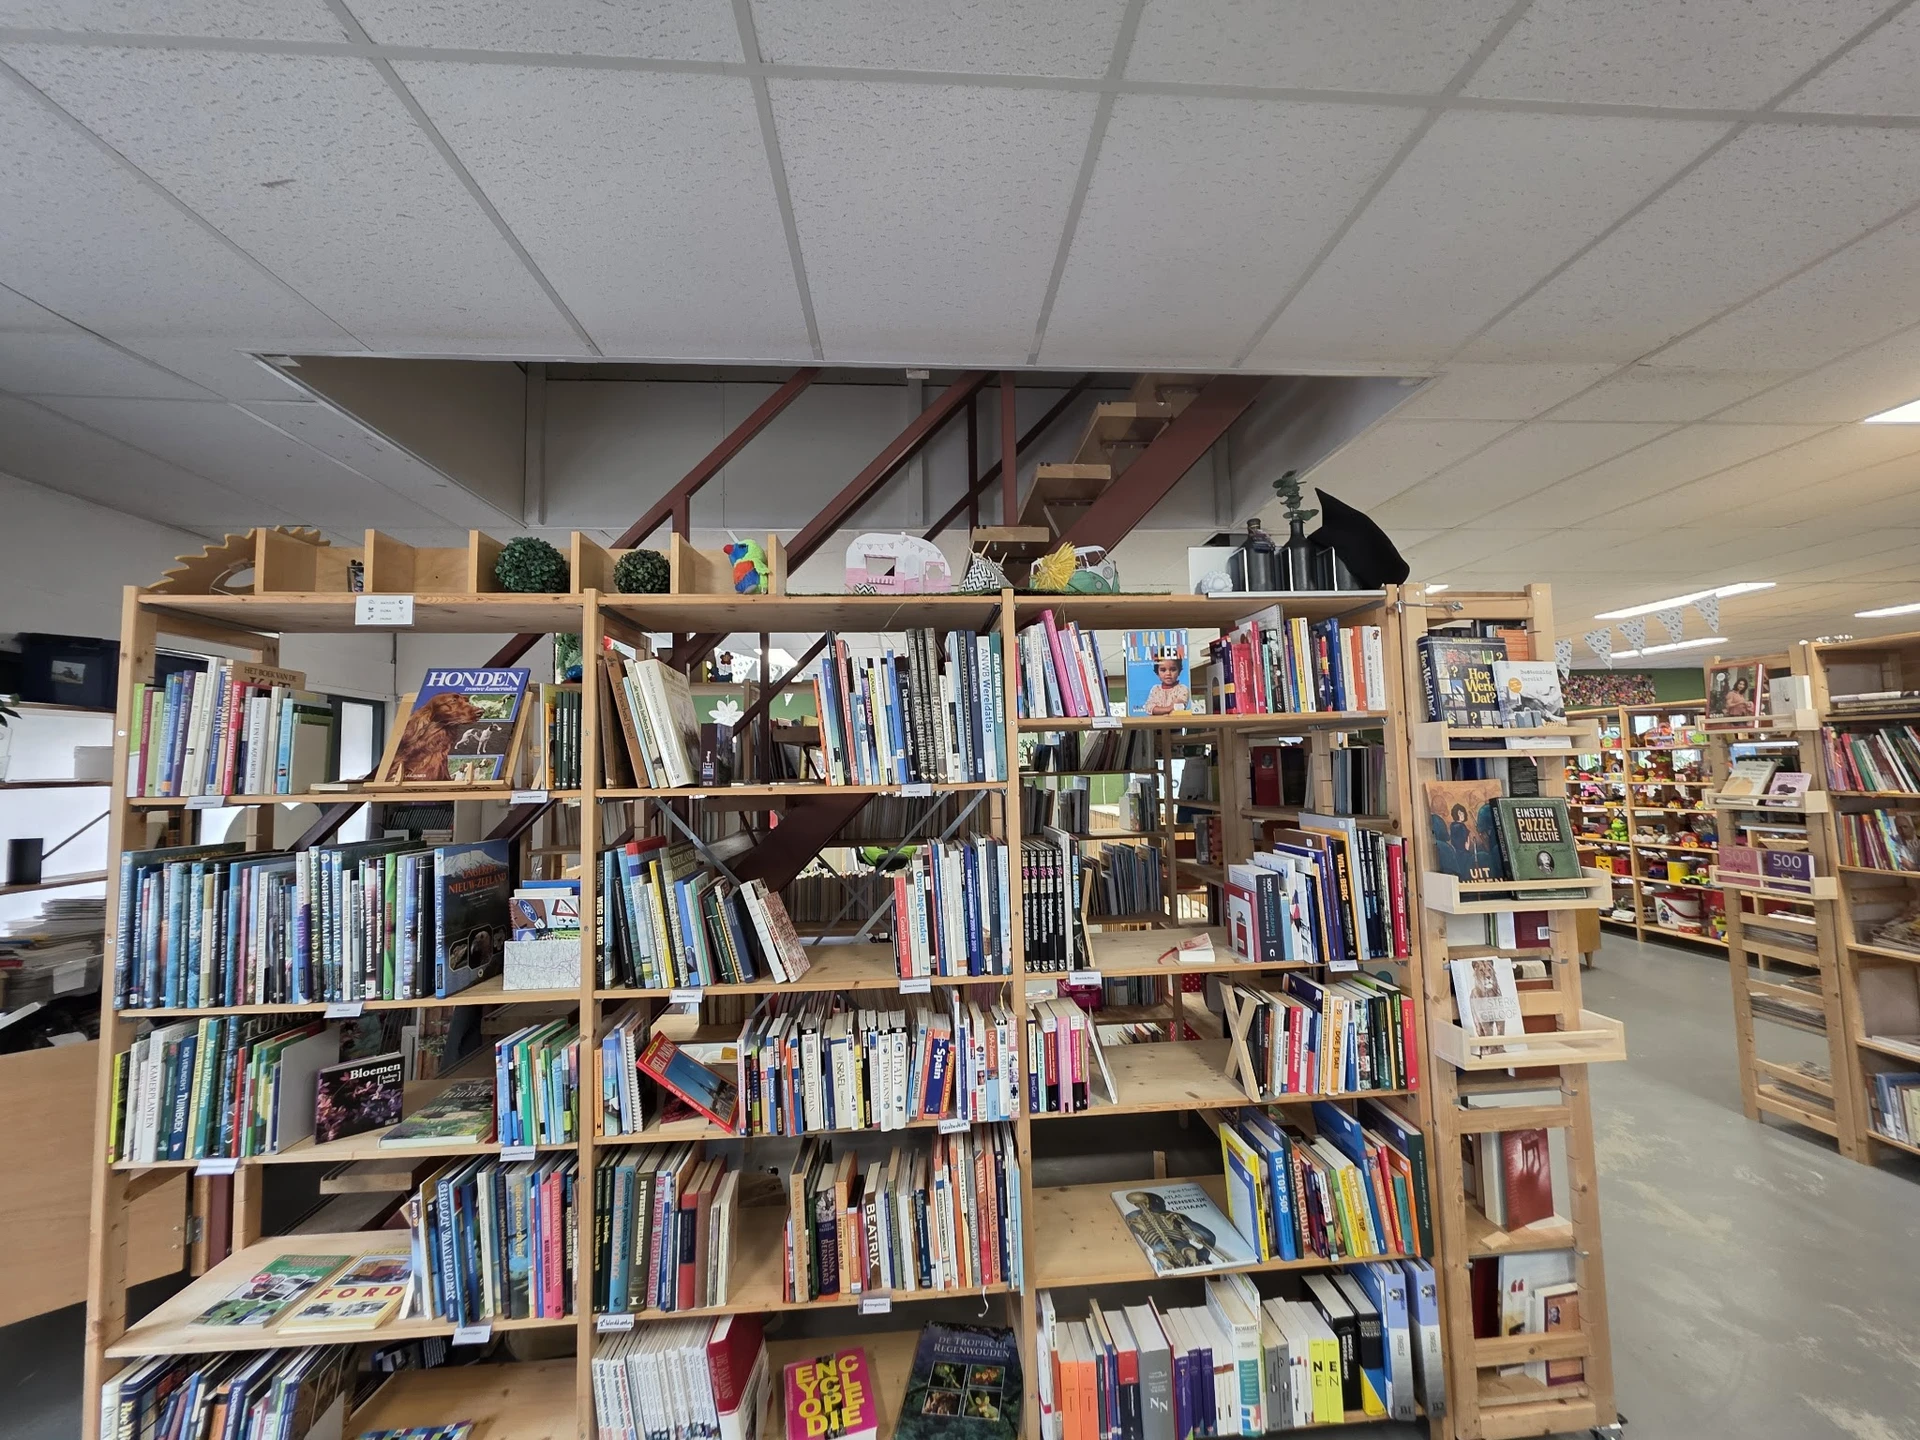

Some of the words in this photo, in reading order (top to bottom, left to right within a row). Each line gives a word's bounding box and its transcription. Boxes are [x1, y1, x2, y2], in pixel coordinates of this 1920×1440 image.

[1127, 633, 1137, 647] IK
[1142, 631, 1165, 647] KAN
[1170, 630, 1187, 645] DIT
[980, 648, 990, 677] ANWB
[1128, 647, 1141, 661] AL
[1145, 645, 1187, 661] ALLEEN!
[244, 667, 258, 675] HET
[258, 668, 274, 678] BOEK
[275, 670, 288, 680] VAN
[289, 674, 297, 682] DE
[427, 672, 524, 687] HONDEN
[1468, 667, 1491, 680] Hoe
[995, 687, 1001, 696] DE
[1420, 650, 1428, 667] Hoe
[1424, 667, 1432, 693] Werkt
[1428, 694, 1437, 717] Dat?
[232, 685, 240, 705] Martin
[863, 677, 873, 725] NIEUW-ZEELAND
[1471, 693, 1496, 704] Dat?
[983, 679, 993, 733] Wereldatlas
[253, 728, 260, 736] EN
[916, 725, 924, 733] EN
[252, 736, 259, 746] UW
[917, 734, 925, 746] HET
[1515, 808, 1554, 817] EINSTEIN
[1518, 818, 1558, 831] PUZZEL
[1520, 832, 1560, 842] COLLECTIE
[1773, 854, 1802, 868] 500
[916, 871, 924, 893] Onze
[1470, 868, 1490, 878] UIT
[310, 862, 319, 923] ONGEREPT
[321, 870, 329, 917] ONGEREPT
[332, 870, 340, 914] ONGEREPT
[134, 901, 142, 919] heeft
[916, 894, 926, 913] lage
[596, 916, 603, 926] IS
[1267, 893, 1275, 937] PHOTOGRAPHS
[918, 914, 927, 944] landen
[310, 928, 319, 963] INDIA
[332, 916, 341, 962] THAILAND
[1488, 997, 1516, 1007] STERK
[1480, 1011, 1518, 1021] GELOOF
[182, 1046, 190, 1059] ROB
[1334, 1047, 1340, 1055] JE
[350, 1063, 400, 1080] Bloemen
[894, 1055, 904, 1087] ITALY
[933, 1048, 945, 1079] Spain
[180, 1060, 189, 1091] VERLINDEN'S
[836, 1061, 845, 1088] ISRAEL
[145, 1065, 157, 1129] KAMERPLANTEN
[173, 1092, 188, 1134] TUINBOEK
[1275, 1157, 1284, 1172] DE
[615, 1173, 624, 1208] TWEEDE
[640, 1180, 647, 1190] DE
[657, 1176, 666, 1187] DE
[1276, 1173, 1286, 1193] TOP
[438, 1181, 450, 1227] GROOT
[552, 1178, 560, 1242] WERELDBEROEMDE
[638, 1190, 646, 1216] TWEEDE
[654, 1190, 665, 1228] TWEEDE
[989, 1195, 997, 1226] JULIANA
[1168, 1197, 1207, 1205] MENSELIJK
[1172, 1203, 1207, 1211] LICHAAM
[1280, 1195, 1288, 1214] 500
[1292, 1157, 1304, 1197] JOHAN
[1299, 1199, 1311, 1246] CRUIJFF
[1351, 1186, 1361, 1215] Smeets
[1358, 1217, 1366, 1232] TOP
[969, 1198, 977, 1239] BERNHARD
[611, 1210, 623, 1280] WERELDOORLOG
[635, 1216, 645, 1265] WERELDOORLOG
[866, 1203, 879, 1269] BEATRIX
[621, 1253, 628, 1261] de
[991, 1231, 999, 1270] BERNHARD
[441, 1229, 455, 1301] VAARBOEK
[553, 1243, 561, 1287] TREINREIZEN
[648, 1231, 663, 1306] WERELDOORLOG
[821, 1239, 829, 1285] BERNHARD
[315, 1286, 403, 1299] FORD
[933, 1343, 1011, 1358] REGENWOUDEN
[955, 1337, 1008, 1349] TROPISCHE
[716, 1354, 728, 1366] DE
[1314, 1361, 1323, 1372] N
[1330, 1362, 1337, 1372] E
[718, 1367, 733, 1399] BALANS
[1315, 1378, 1322, 1387] E
[1329, 1377, 1339, 1387] N
[600, 1378, 609, 1410] aanzien
[614, 1379, 623, 1411] aanzien
[1400, 1406, 1412, 1414] B1
[1432, 1401, 1444, 1411] B2
[618, 1412, 626, 1428] van
